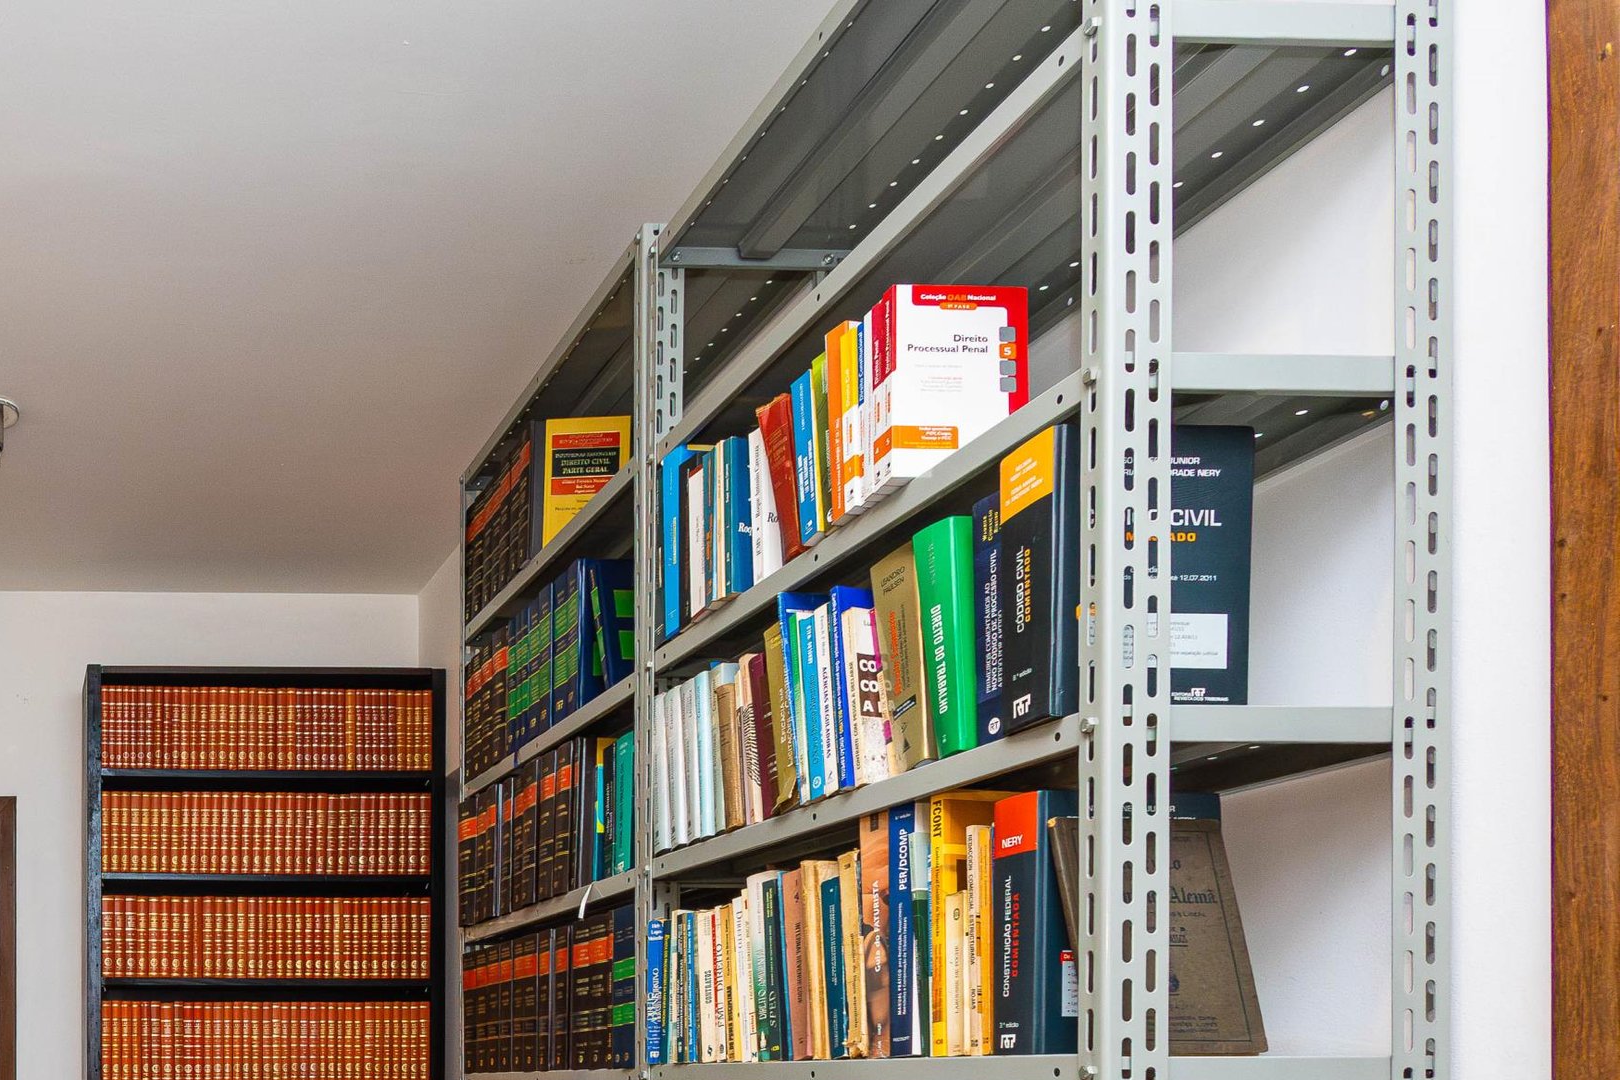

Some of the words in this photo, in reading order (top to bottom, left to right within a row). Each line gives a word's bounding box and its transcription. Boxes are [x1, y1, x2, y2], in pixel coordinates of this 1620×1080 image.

[920, 293, 947, 302] Coleção
[967, 293, 997, 302] Nacional
[907, 343, 959, 353] Processual
[962, 345, 988, 354] Penal
[953, 334, 988, 343] Direito
[1003, 347, 1012, 356] 5
[1197, 469, 1221, 477] NERY
[1170, 509, 1222, 526] CIVIL
[1015, 545, 1024, 581] CIVIL
[990, 575, 998, 618] PROCESSO
[1014, 584, 1025, 633] CÓDIGO
[929, 603, 943, 644] DIREITO
[991, 620, 998, 632] DE
[935, 645, 944, 662] DO
[989, 633, 998, 665] CÓDIGO
[935, 663, 949, 715] TRABALHO
[990, 666, 998, 690] NOVO
[823, 704, 832, 759] REGULADORAS
[932, 799, 942, 837] FCONT
[897, 828, 910, 891] PER/DCOMP
[1000, 834, 1024, 850] NERY
[872, 880, 881, 933] FATURISTA
[1002, 875, 1012, 921] FEDERAL
[872, 935, 881, 948] do
[968, 914, 976, 966] ESTRUCTURADA
[1011, 892, 1021, 978] COMENTADA
[874, 950, 882, 972] Guia
[1002, 923, 1013, 998] CONSTITUIÇÃO
[704, 970, 713, 1004] CONTRATOS
[768, 990, 777, 1029] SPED
